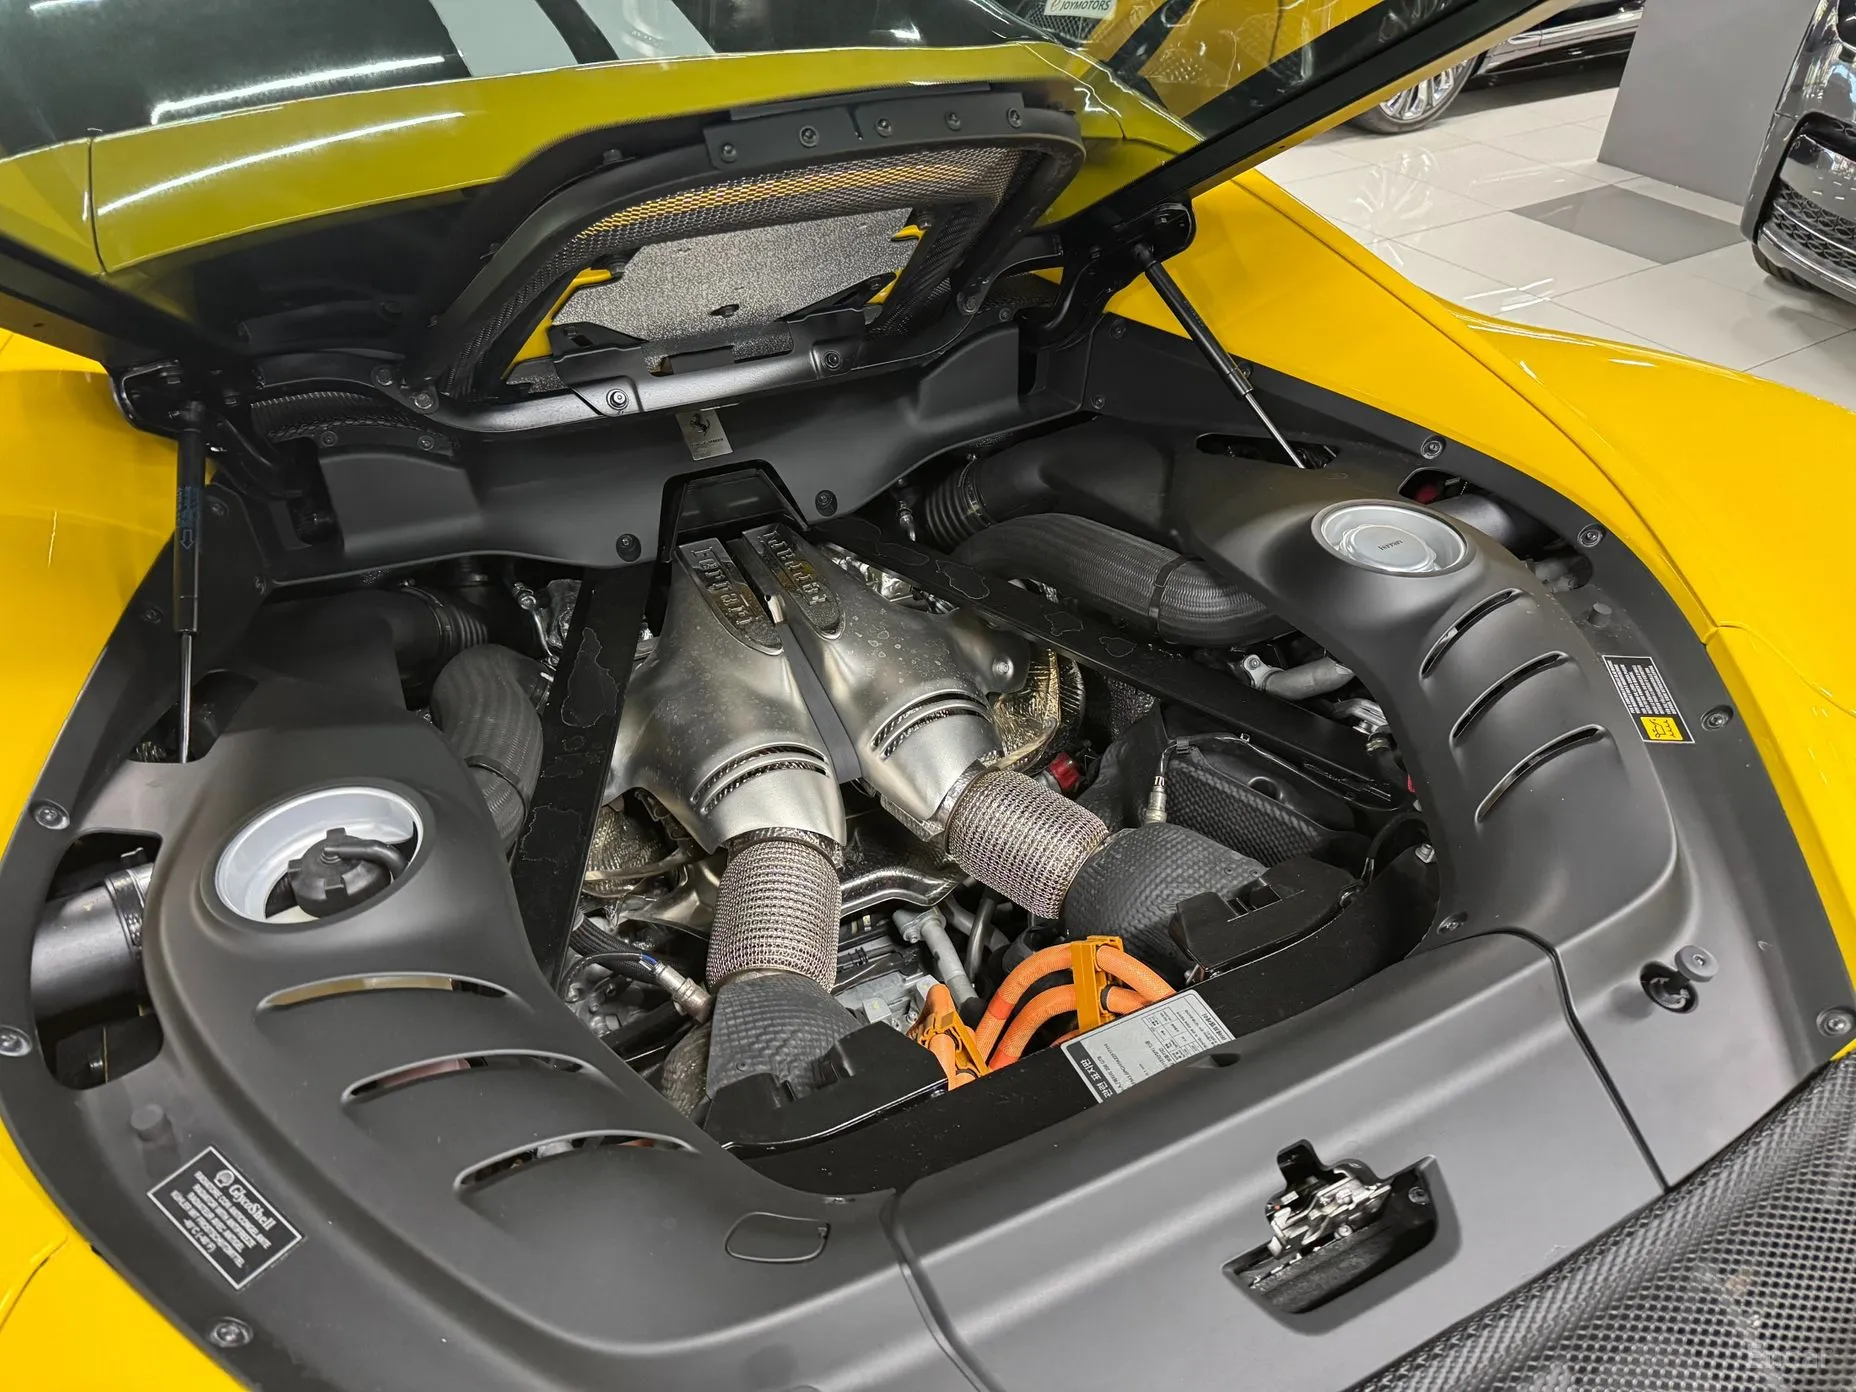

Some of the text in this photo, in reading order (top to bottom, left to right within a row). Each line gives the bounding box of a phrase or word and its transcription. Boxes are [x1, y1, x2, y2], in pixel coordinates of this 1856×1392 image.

[1060, 0, 1111, 11] JOYMOTORS
[691, 546, 763, 625] Ferrari
[228, 1184, 276, 1231] GlycoShell
